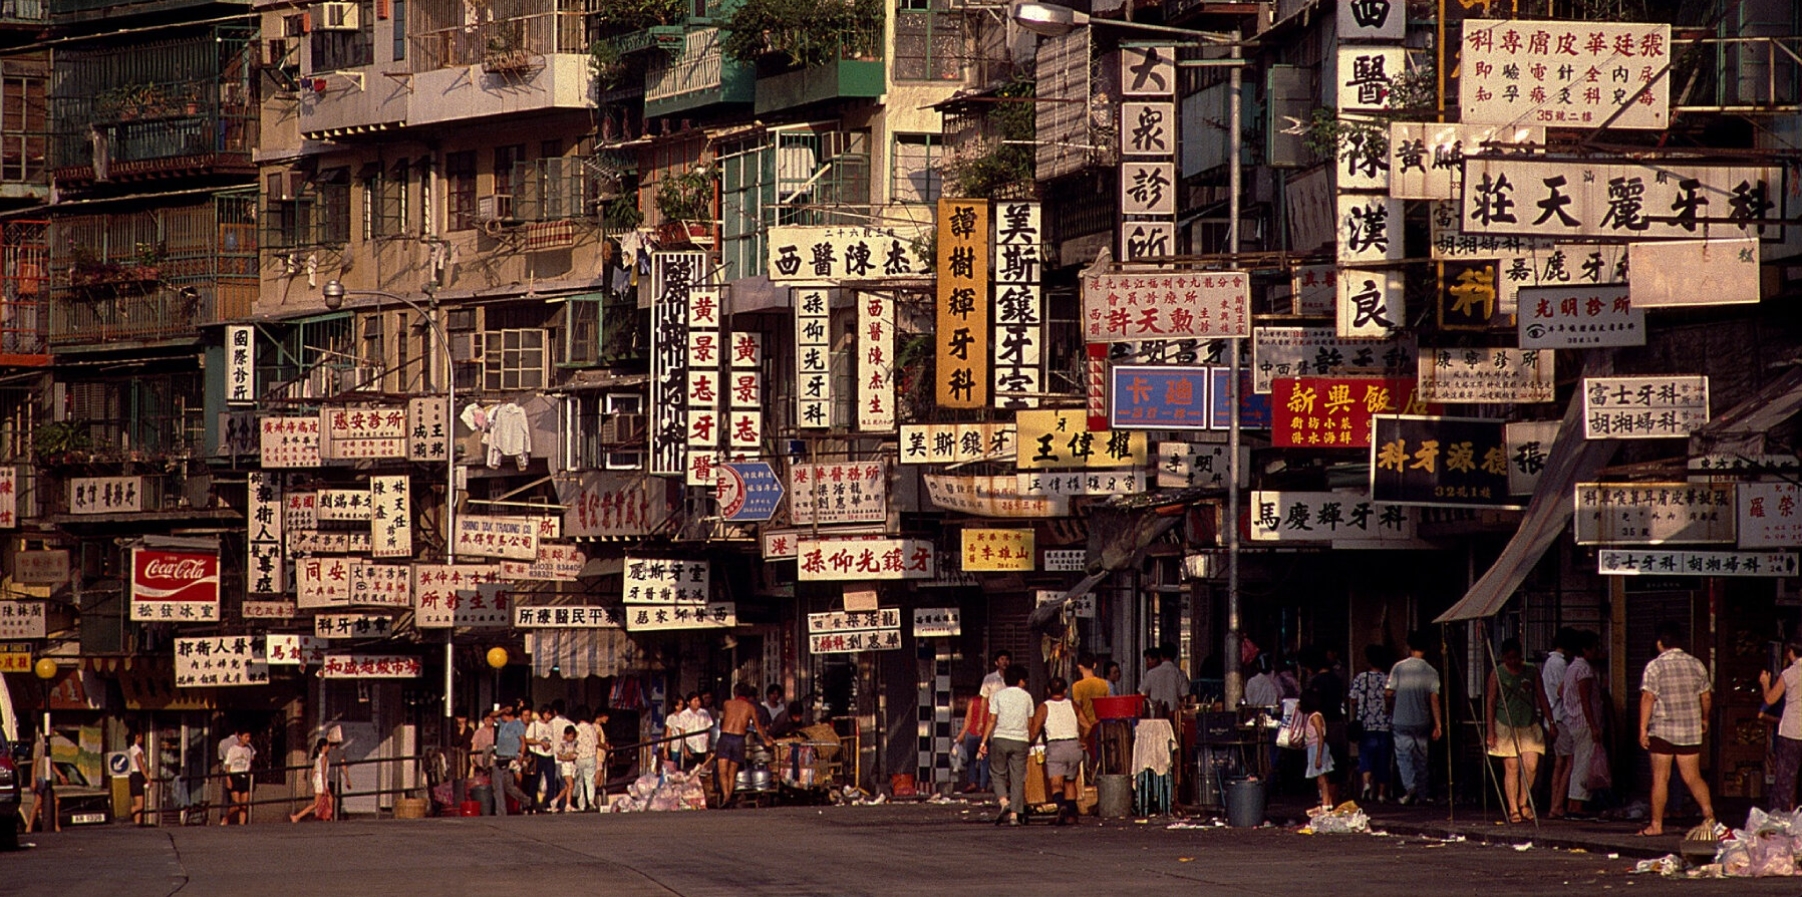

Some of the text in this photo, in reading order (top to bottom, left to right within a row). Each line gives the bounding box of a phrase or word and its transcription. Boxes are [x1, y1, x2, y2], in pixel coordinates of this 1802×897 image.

[1471, 172, 1775, 235] 莊天麗牙科
[948, 206, 978, 402] 譚樹輝牙科
[1534, 295, 1630, 318] 光明診所
[802, 292, 826, 426] 孫仰光牙科
[867, 299, 885, 414] 西醫陳杰生
[689, 296, 717, 480] 黃景志牙醫
[1588, 382, 1681, 406] 富士牙科
[462, 521, 478, 531] SHING
[496, 522, 520, 534] TRADING
[1253, 501, 1408, 532] 馬慶輝牙科
[144, 558, 207, 580] Coca-Cola
[1604, 555, 1677, 571] 富士牙科
